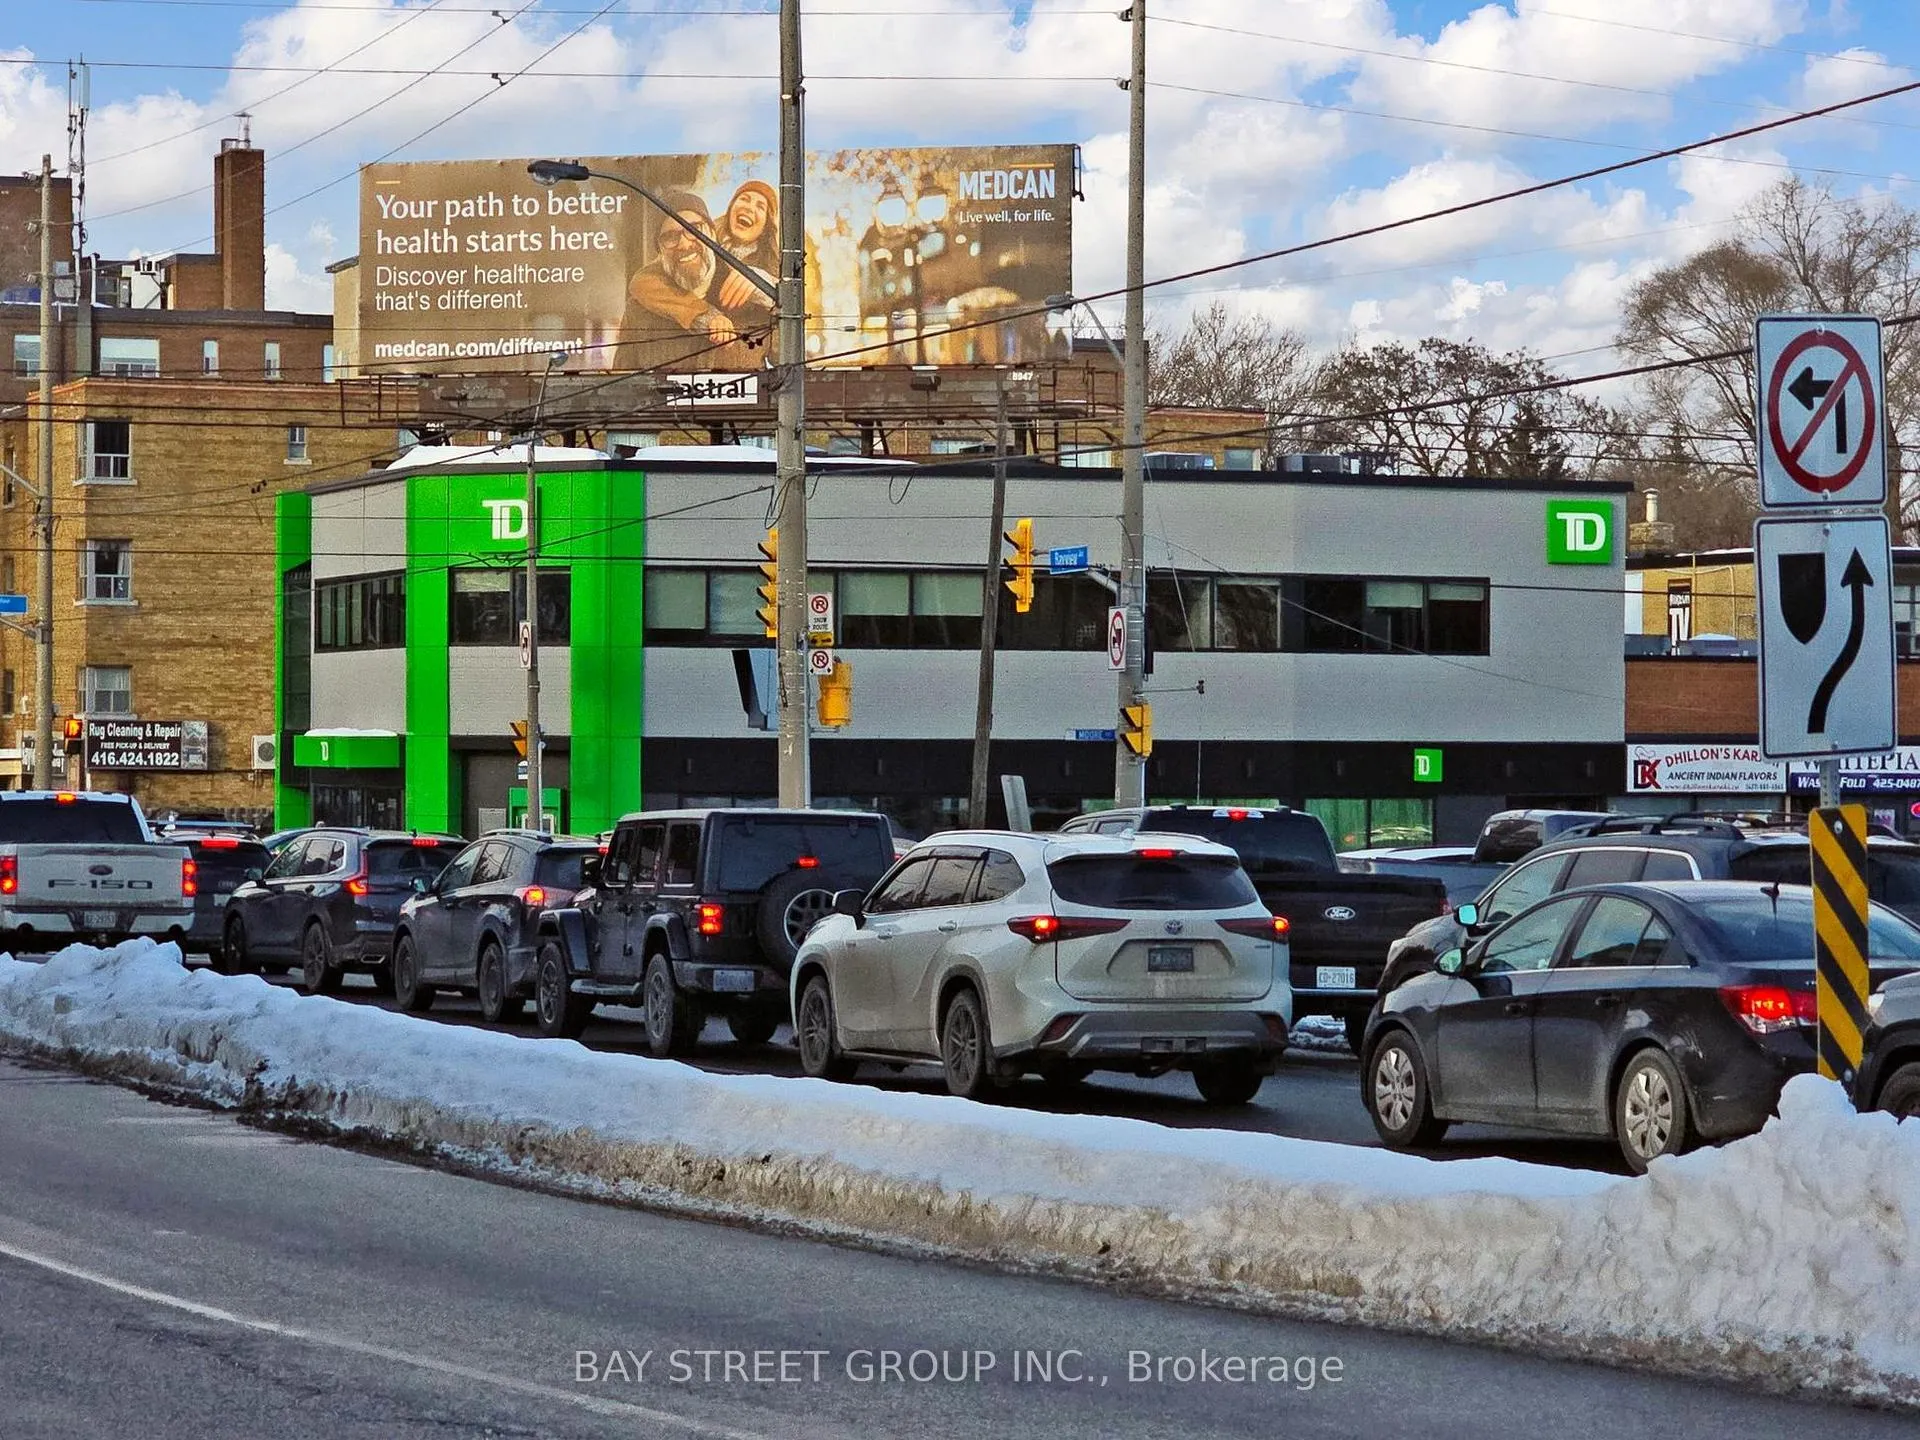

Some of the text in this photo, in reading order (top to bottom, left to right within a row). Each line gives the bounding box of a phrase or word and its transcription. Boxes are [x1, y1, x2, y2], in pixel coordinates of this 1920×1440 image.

[959, 170, 1056, 200] MEDCAN
[375, 190, 628, 225] Your path to better
[960, 208, 1055, 223] Live well, for life.
[376, 225, 614, 254] health starts here.
[376, 263, 585, 287] Discover healthcare
[375, 289, 528, 311] that's different.
[374, 337, 584, 358] medcan.com/different
[481, 499, 529, 540] TD
[1556, 512, 1606, 551] TD
[89, 723, 181, 740] Rug Cleaning & Repair
[91, 751, 180, 767] 416.424.1822
[1415, 755, 1430, 776] TD
[1665, 748, 1731, 768] DHILLON'S
[1634, 759, 1662, 789] DK
[1666, 771, 1778, 781] ANCIENT INDIAN FLAVORS
[1840, 776, 1866, 788] FOLD
[48, 879, 153, 889] F-150
